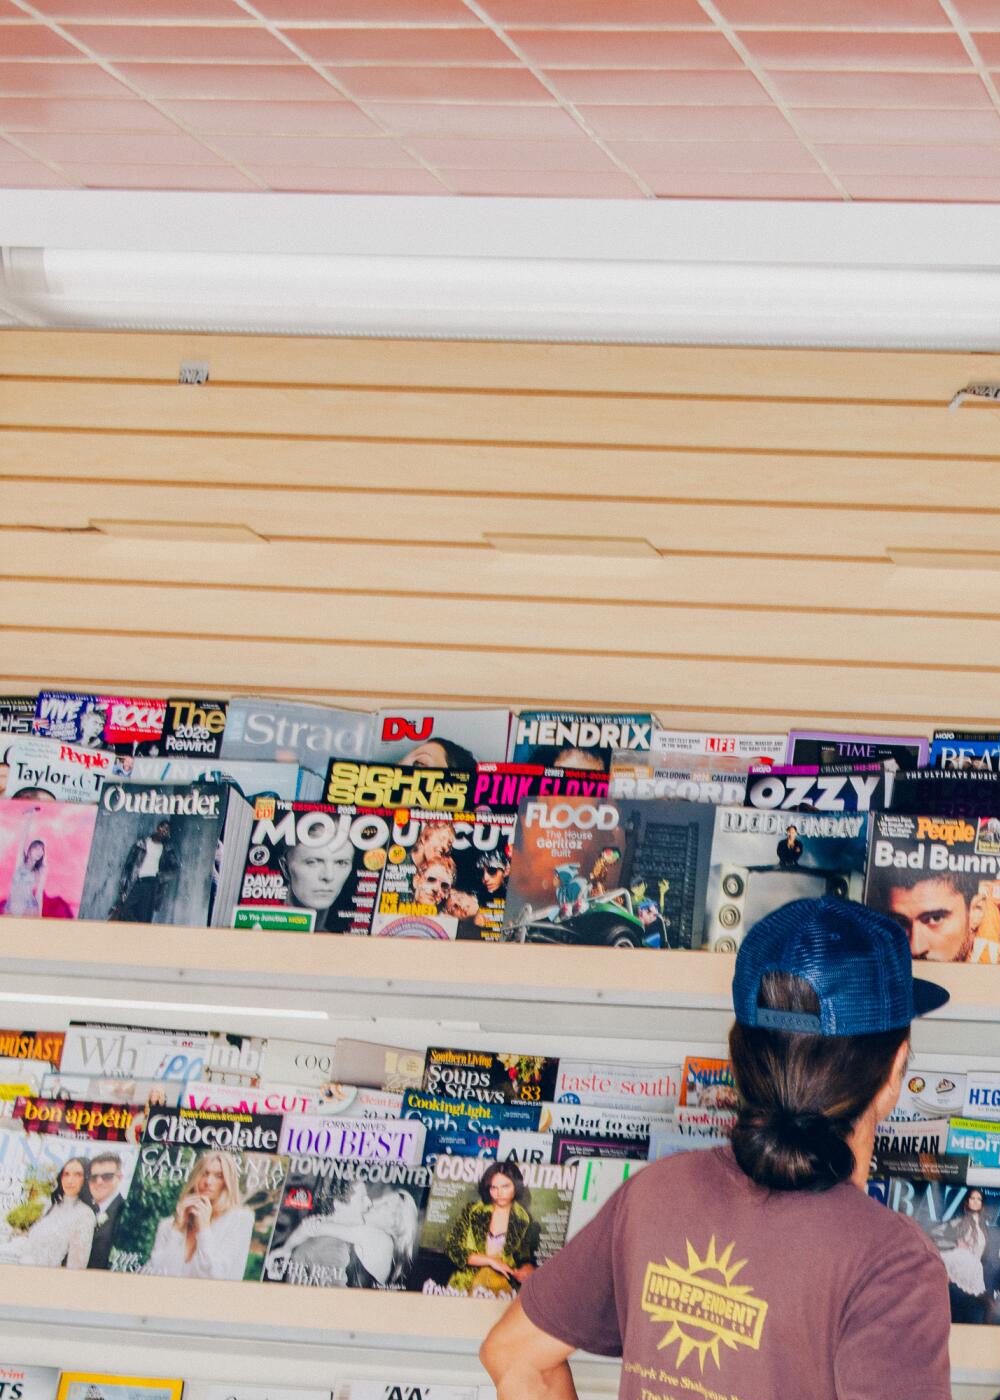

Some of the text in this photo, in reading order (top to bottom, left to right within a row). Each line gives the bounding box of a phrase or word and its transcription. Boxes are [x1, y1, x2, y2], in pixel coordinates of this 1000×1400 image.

[40, 700, 81, 720] VIVE
[168, 701, 225, 734] The
[243, 711, 367, 755] Strad
[381, 717, 434, 741] DJ
[516, 719, 653, 751] HENDRIX
[165, 735, 216, 753] Rewind
[705, 737, 735, 753] LIFE
[837, 743, 876, 758] TIME
[59, 744, 109, 769] People
[16, 762, 67, 785] Taylor
[331, 762, 444, 793] SIGHT
[654, 769, 747, 784] INCLUDING CALENDAR
[906, 772, 922, 780] THE
[924, 771, 969, 780] ULTIMATE
[971, 772, 997, 781] MUSIC
[327, 782, 467, 812] SOUND
[435, 782, 468, 795] AND
[473, 774, 533, 805] PINK
[614, 779, 746, 801] RECORD
[525, 802, 620, 830] FLOOD
[252, 810, 389, 852] MOJO
[565, 831, 592, 839] House
[916, 815, 975, 845] People
[536, 838, 583, 850] Gorillaz
[874, 841, 925, 870] Bad
[244, 874, 284, 887] DAVID
[242, 886, 288, 899] BOWIE
[379, 902, 437, 915] DAMNED
[430, 1050, 493, 1068] Southern Living
[426, 1064, 491, 1088] Soups
[560, 1071, 677, 1098] taste south
[443, 1084, 505, 1105] Stews
[520, 1084, 541, 1101] 83
[24, 1101, 134, 1130] bon appétit
[560, 1114, 651, 1134] what to eat
[148, 1113, 279, 1151] Chocolate
[286, 1128, 414, 1160] 100 BEST
[649, 1274, 757, 1326] INDEPENDENT
